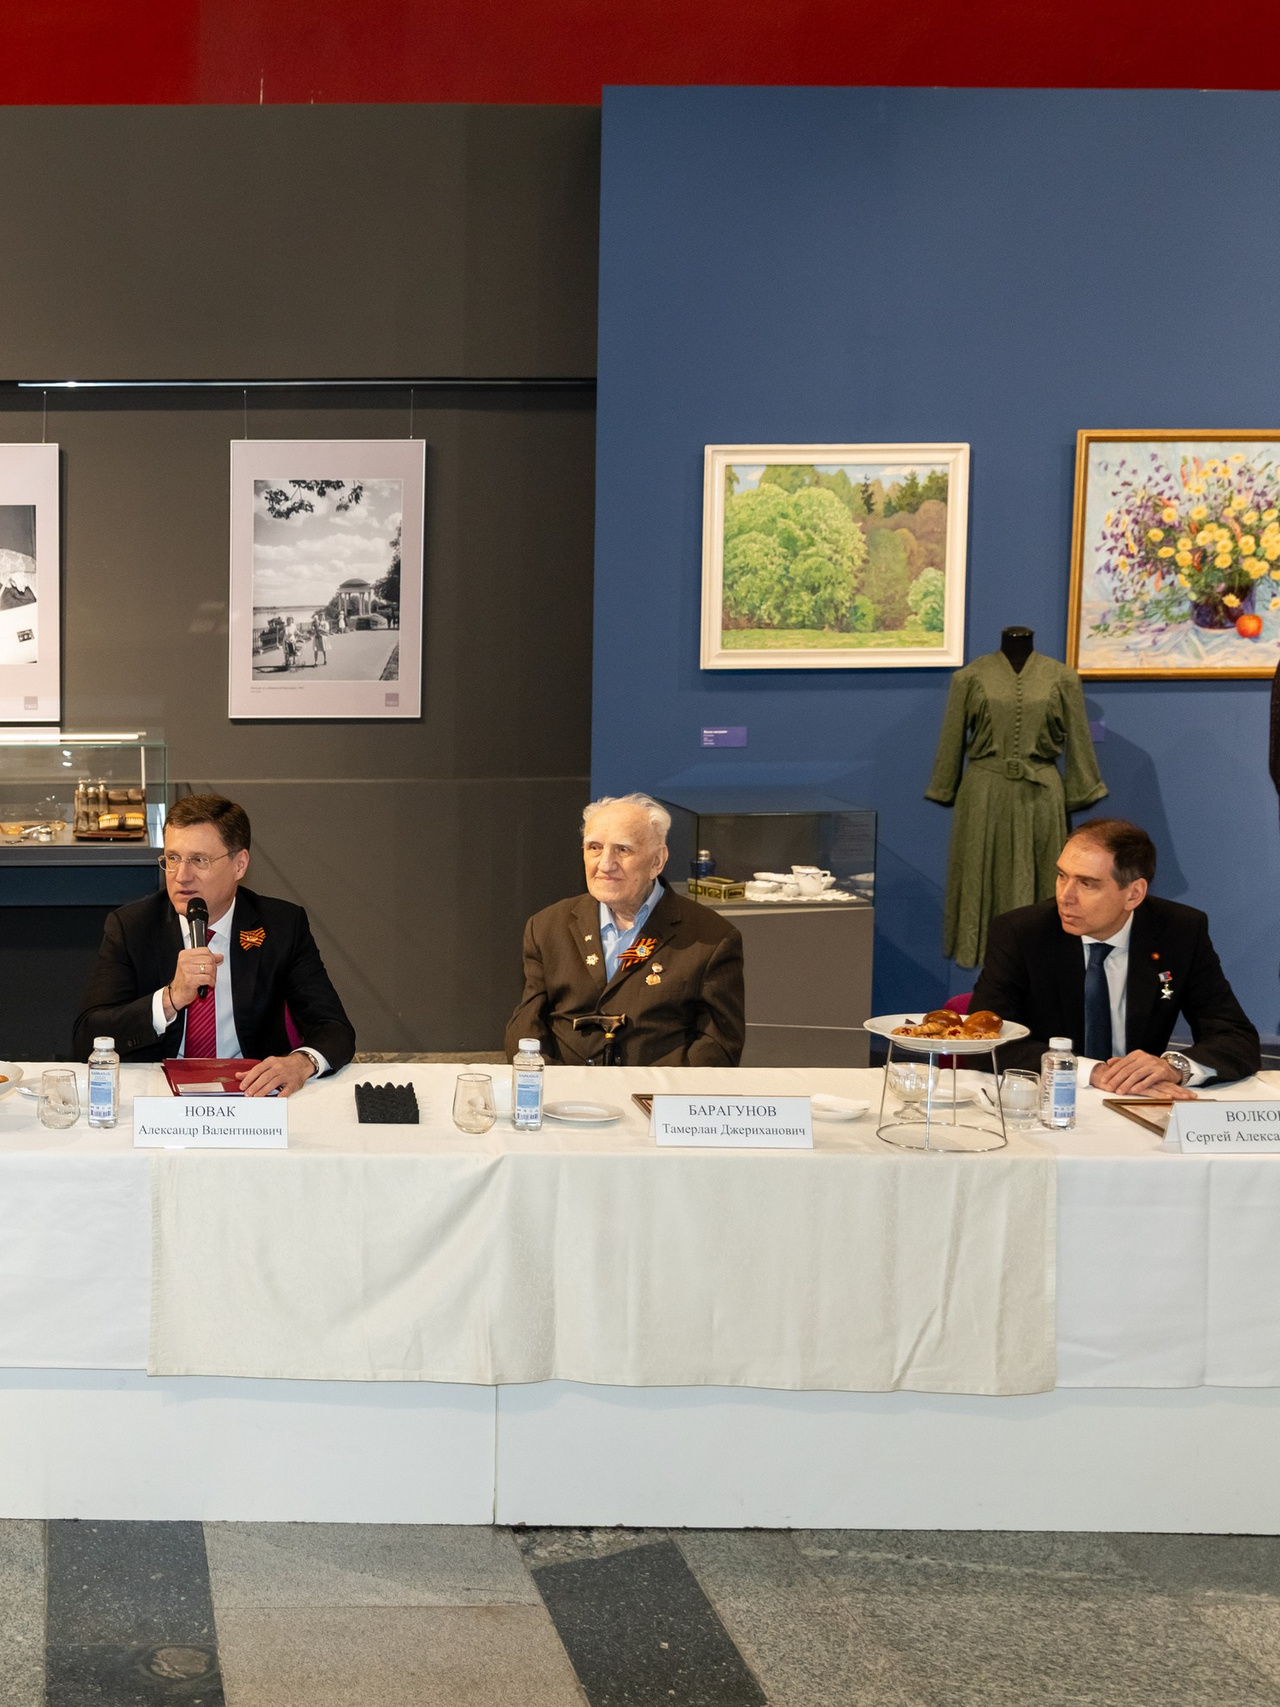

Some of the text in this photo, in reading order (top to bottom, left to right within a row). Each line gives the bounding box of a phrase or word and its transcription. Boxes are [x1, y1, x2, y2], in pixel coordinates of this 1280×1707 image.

[185, 1105, 236, 1118] НОВАК
[688, 1104, 777, 1117] БАРАГУНОВ
[138, 1124, 283, 1138] Александр Валентинович
[661, 1123, 806, 1138] Тамерлан Джериханович
[1185, 1130, 1280, 1146] Сергей Алекса
